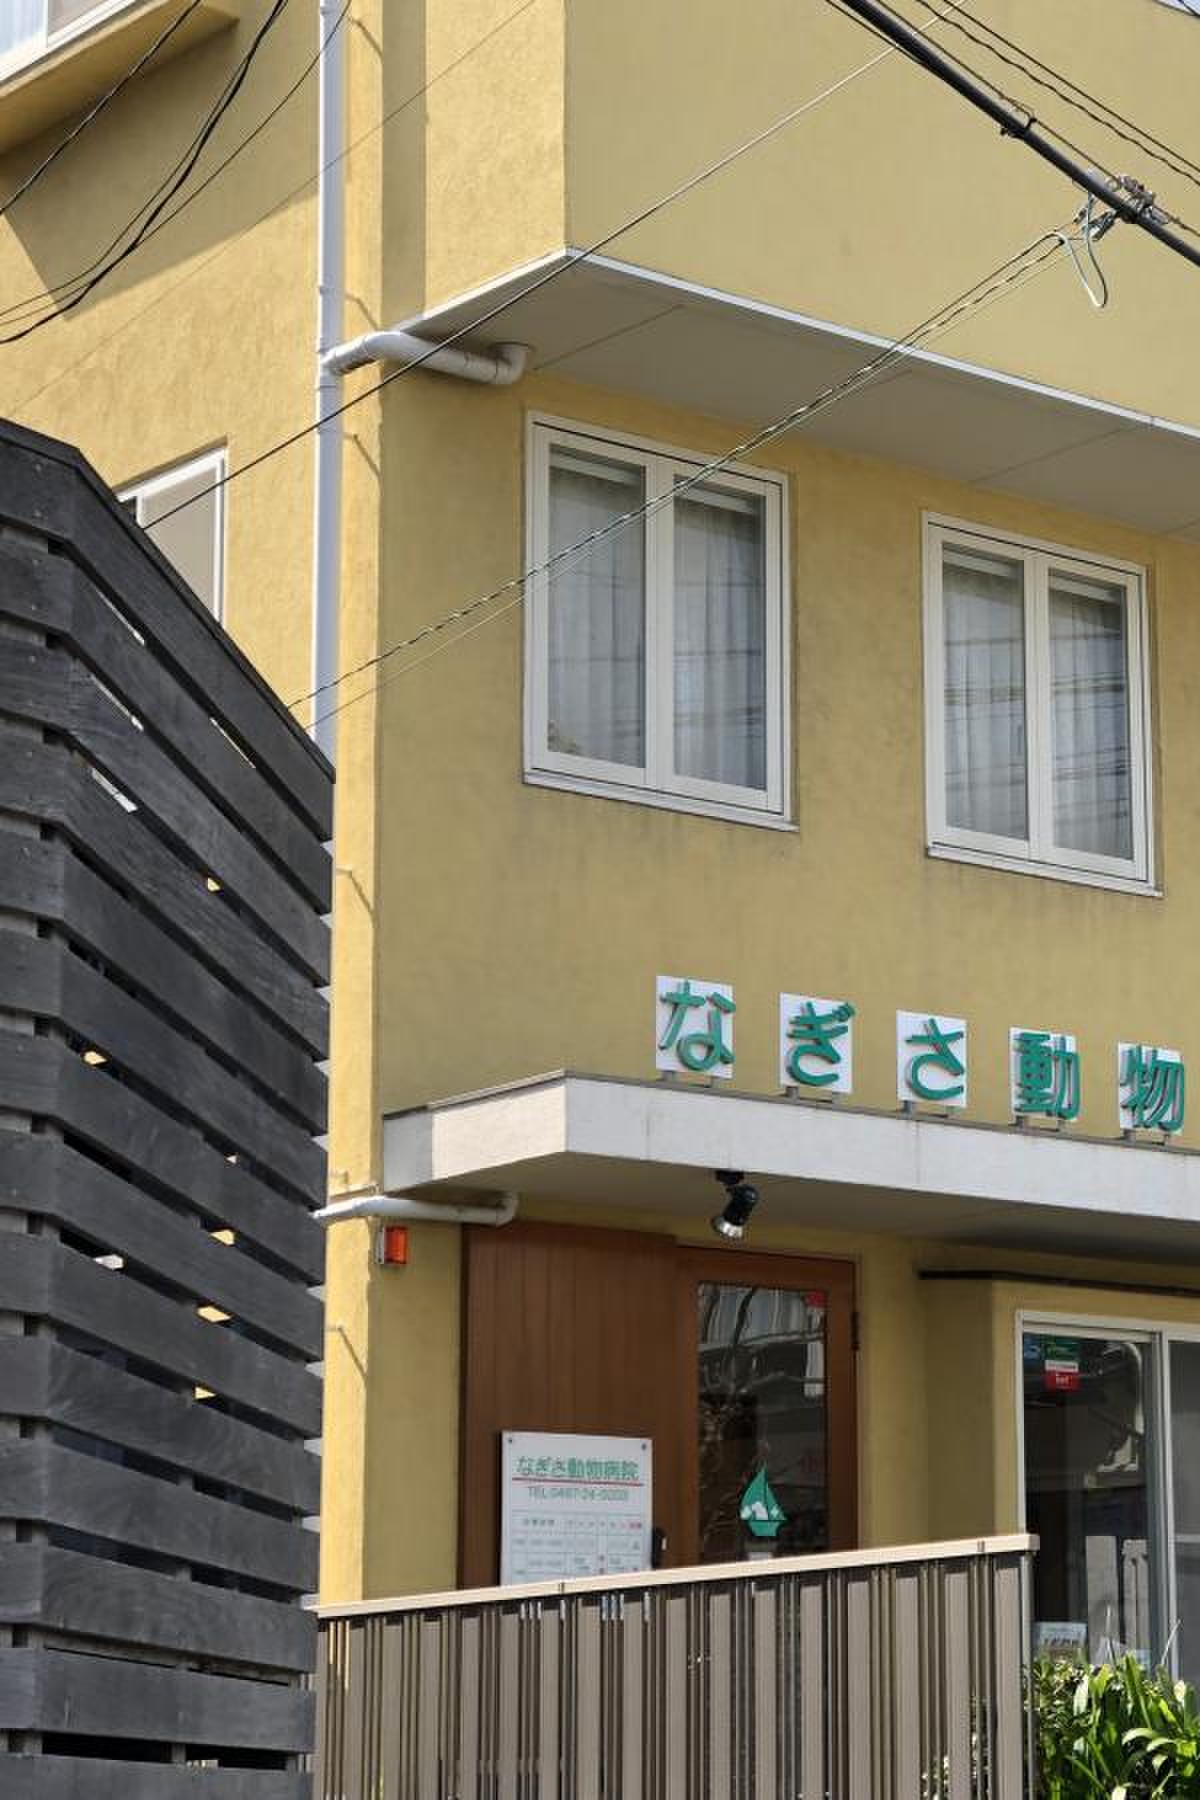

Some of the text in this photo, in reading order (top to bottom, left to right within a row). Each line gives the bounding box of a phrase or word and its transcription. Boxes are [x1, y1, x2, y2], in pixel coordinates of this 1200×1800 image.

[516, 1455, 640, 1481] なぎさ動物病院
